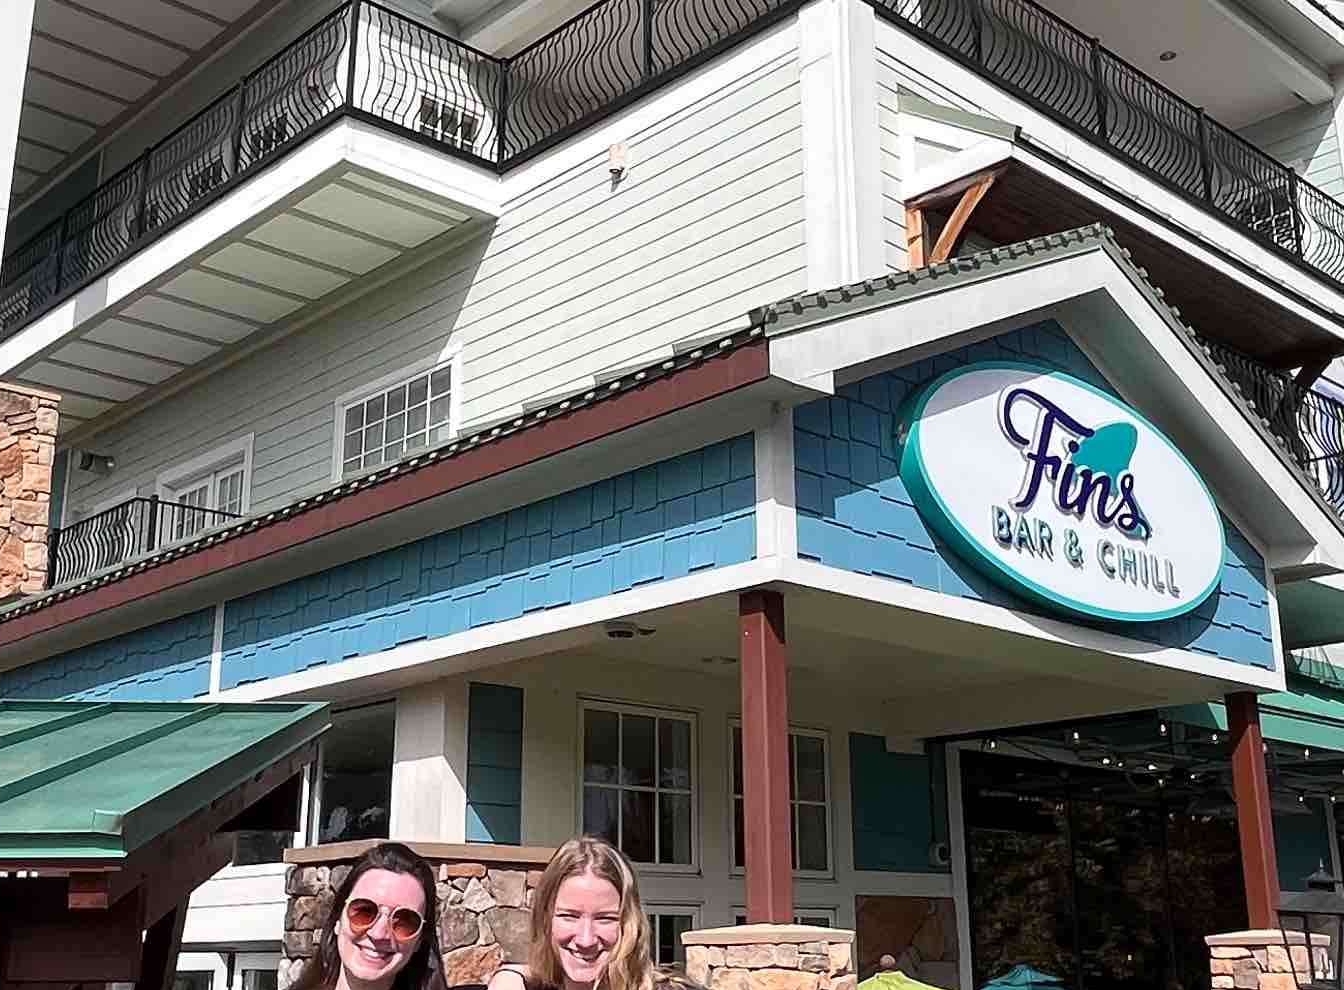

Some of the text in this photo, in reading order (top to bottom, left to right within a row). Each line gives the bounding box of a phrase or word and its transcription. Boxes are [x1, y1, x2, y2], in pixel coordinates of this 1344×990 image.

[1002, 387, 1152, 540] Fins
[991, 505, 1180, 599] BAR & CHILL
